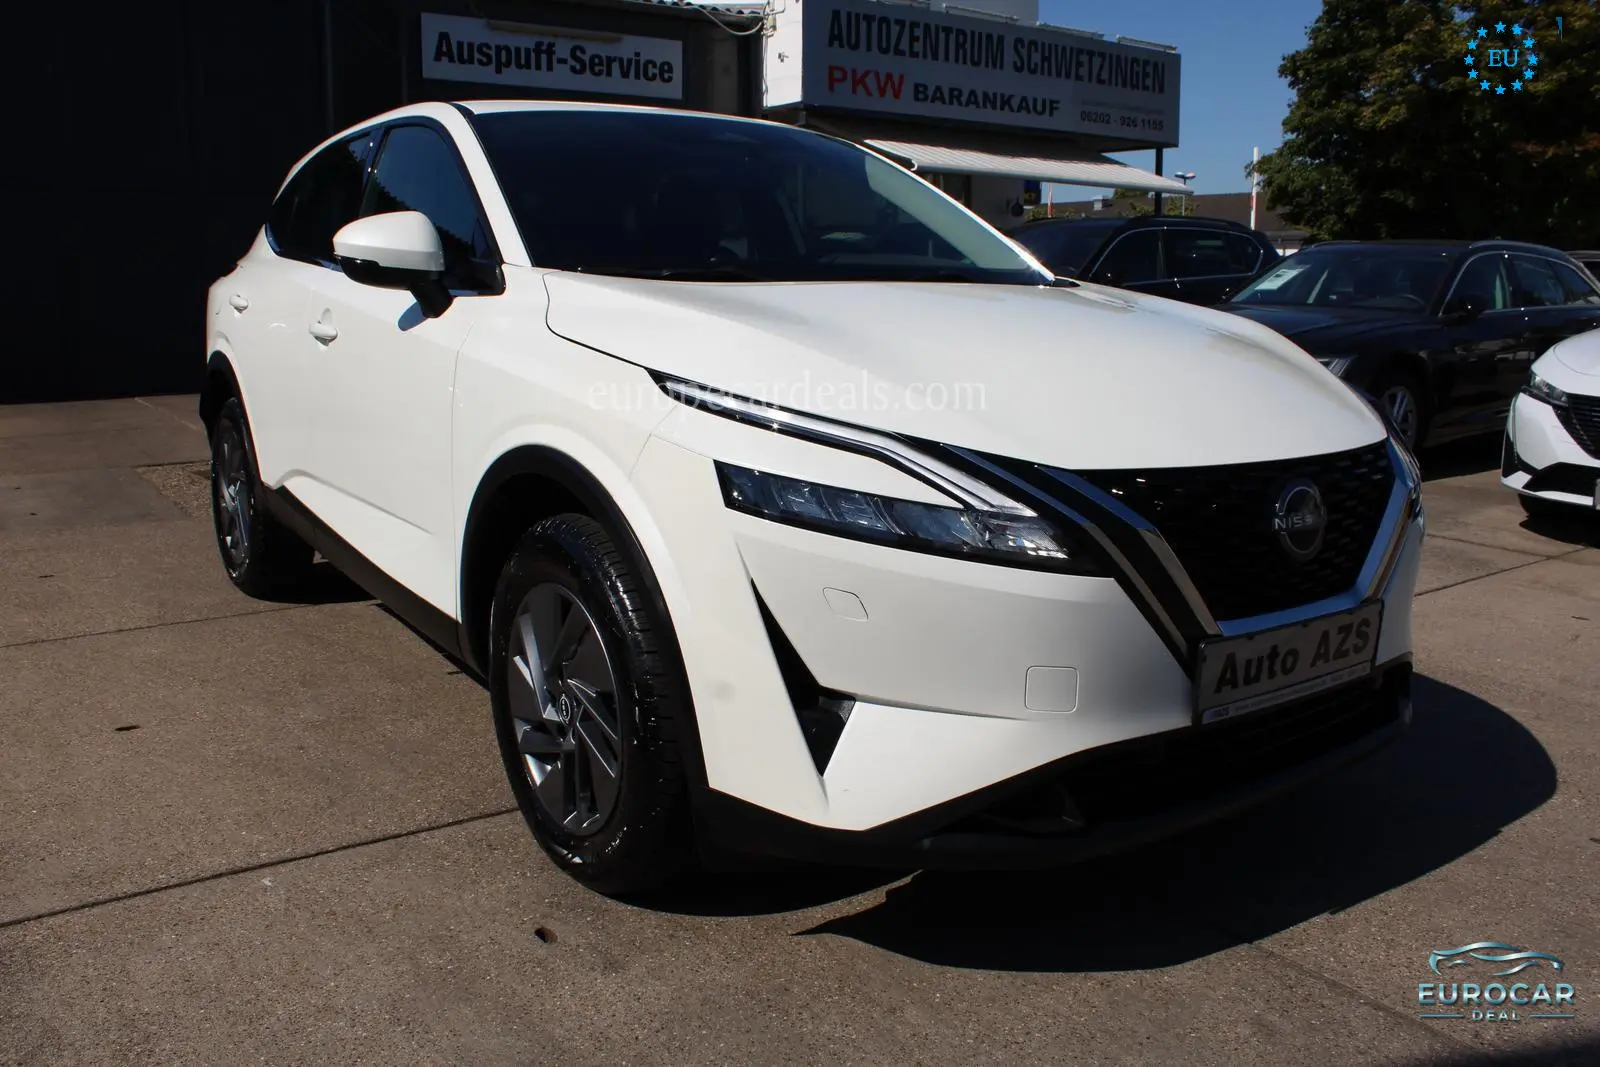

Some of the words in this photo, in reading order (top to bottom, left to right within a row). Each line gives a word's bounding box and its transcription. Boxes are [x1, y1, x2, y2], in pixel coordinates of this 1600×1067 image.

[432, 31, 674, 84] Auspuff-Service
[828, 9, 1005, 71] AUTOZENTRUM
[1012, 36, 1166, 95] SCHWETZINGEN
[827, 64, 905, 101] PKW
[912, 82, 1061, 118] BARANKAUF
[1213, 643, 1300, 694] Auto
[1310, 616, 1372, 669] AZS
